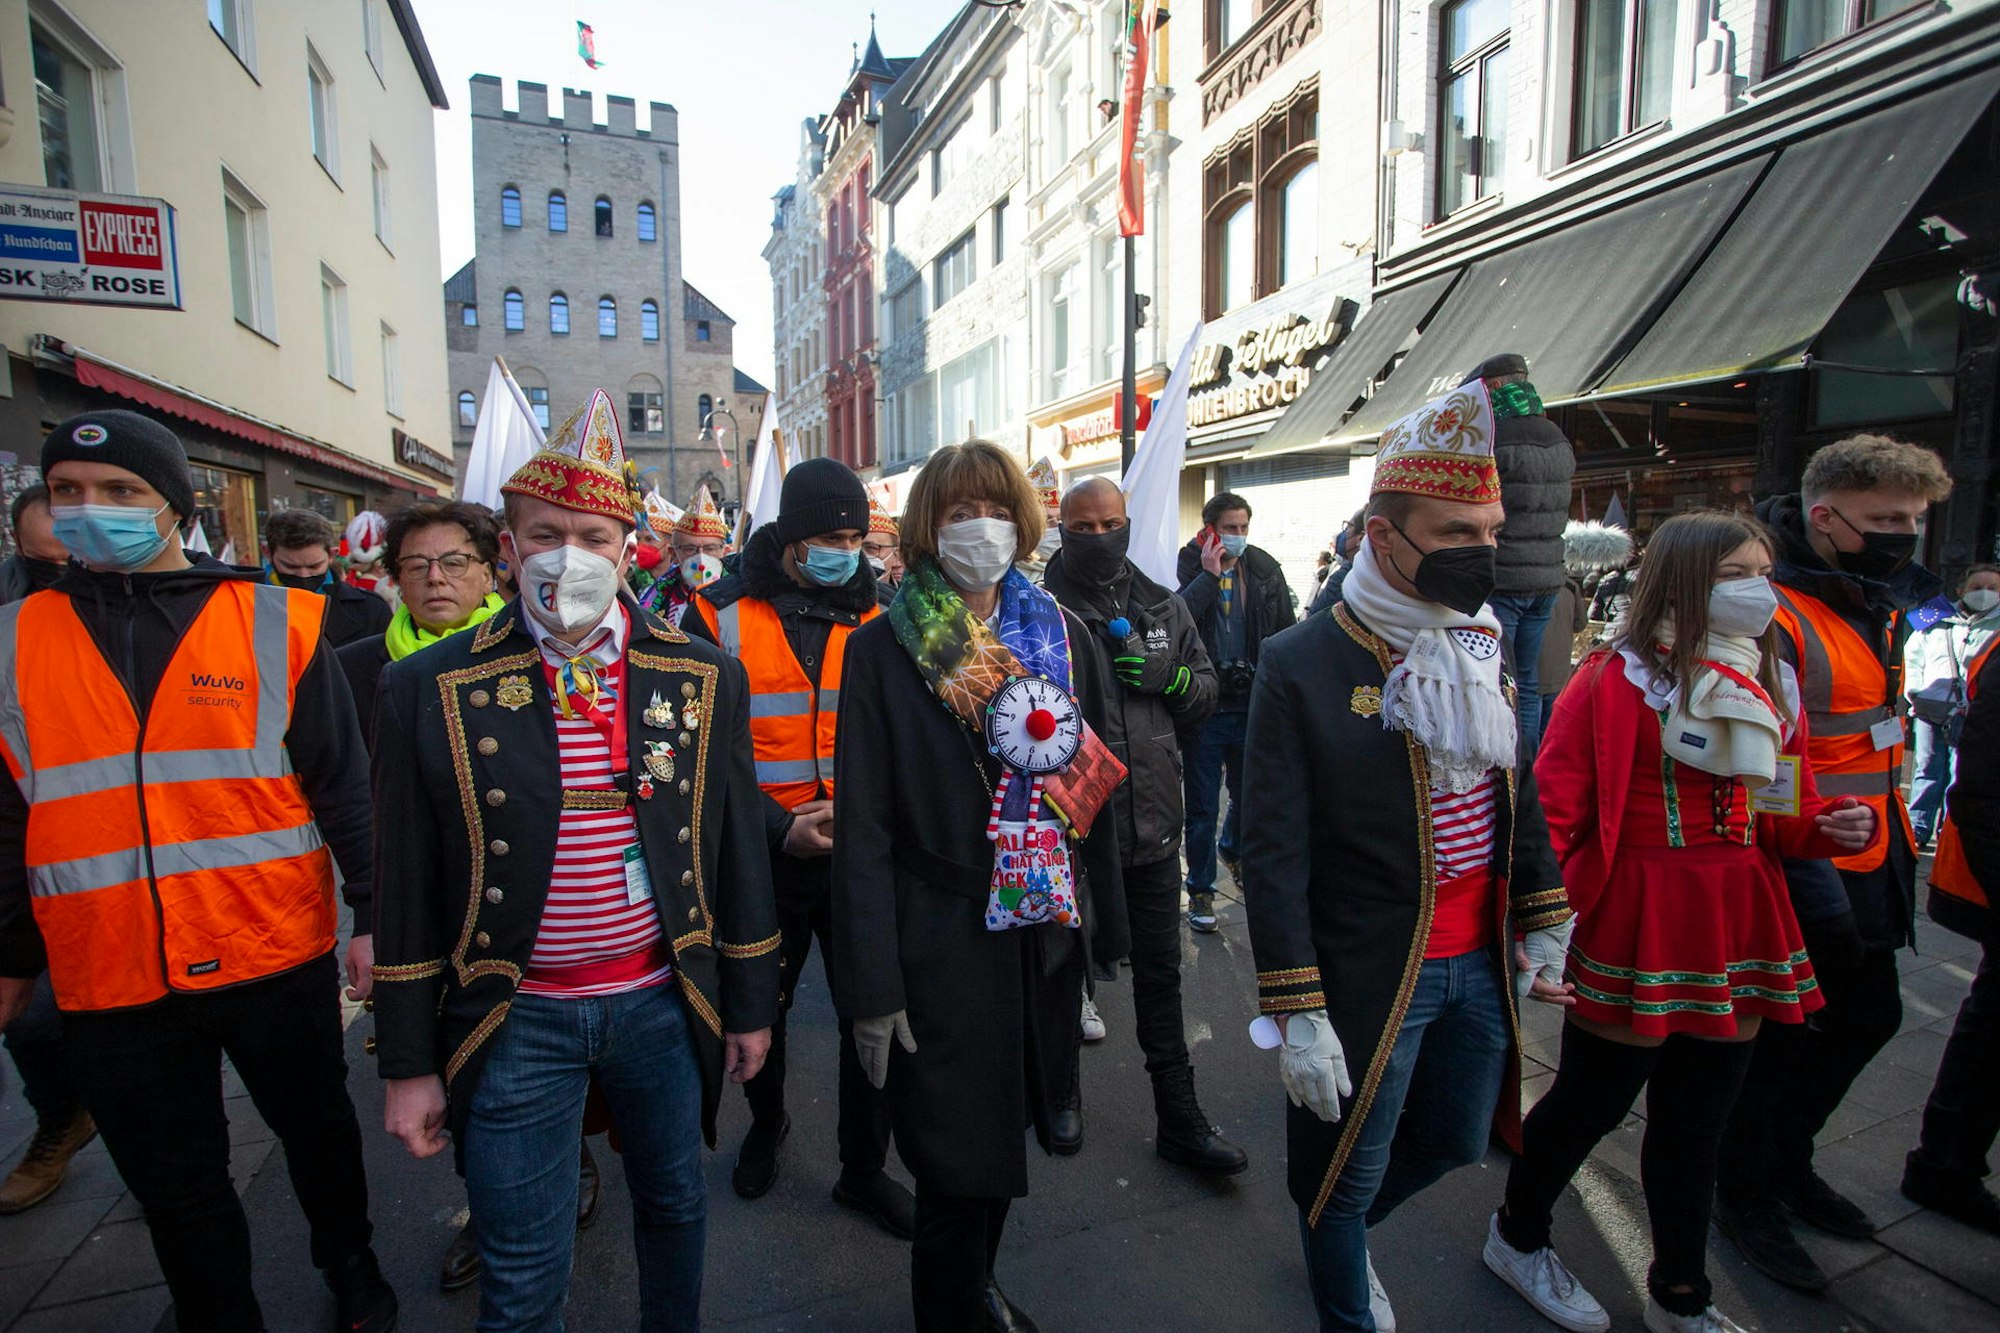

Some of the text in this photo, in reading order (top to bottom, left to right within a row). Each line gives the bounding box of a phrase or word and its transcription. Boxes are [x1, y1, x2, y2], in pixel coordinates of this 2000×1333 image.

[0, 203, 75, 222] adt-Anzeiger
[83, 210, 159, 257] EXPRESS
[0, 268, 166, 296] SK ROSE
[1189, 296, 1344, 389] ild Geflügel
[1187, 366, 1311, 428] HLENBROCH
[191, 673, 245, 691] WuVo
[187, 696, 242, 710] security
[1038, 695, 1047, 704] 12
[1010, 713, 1016, 722] 9
[1059, 727, 1064, 736] 3
[1029, 745, 1035, 754] 6
